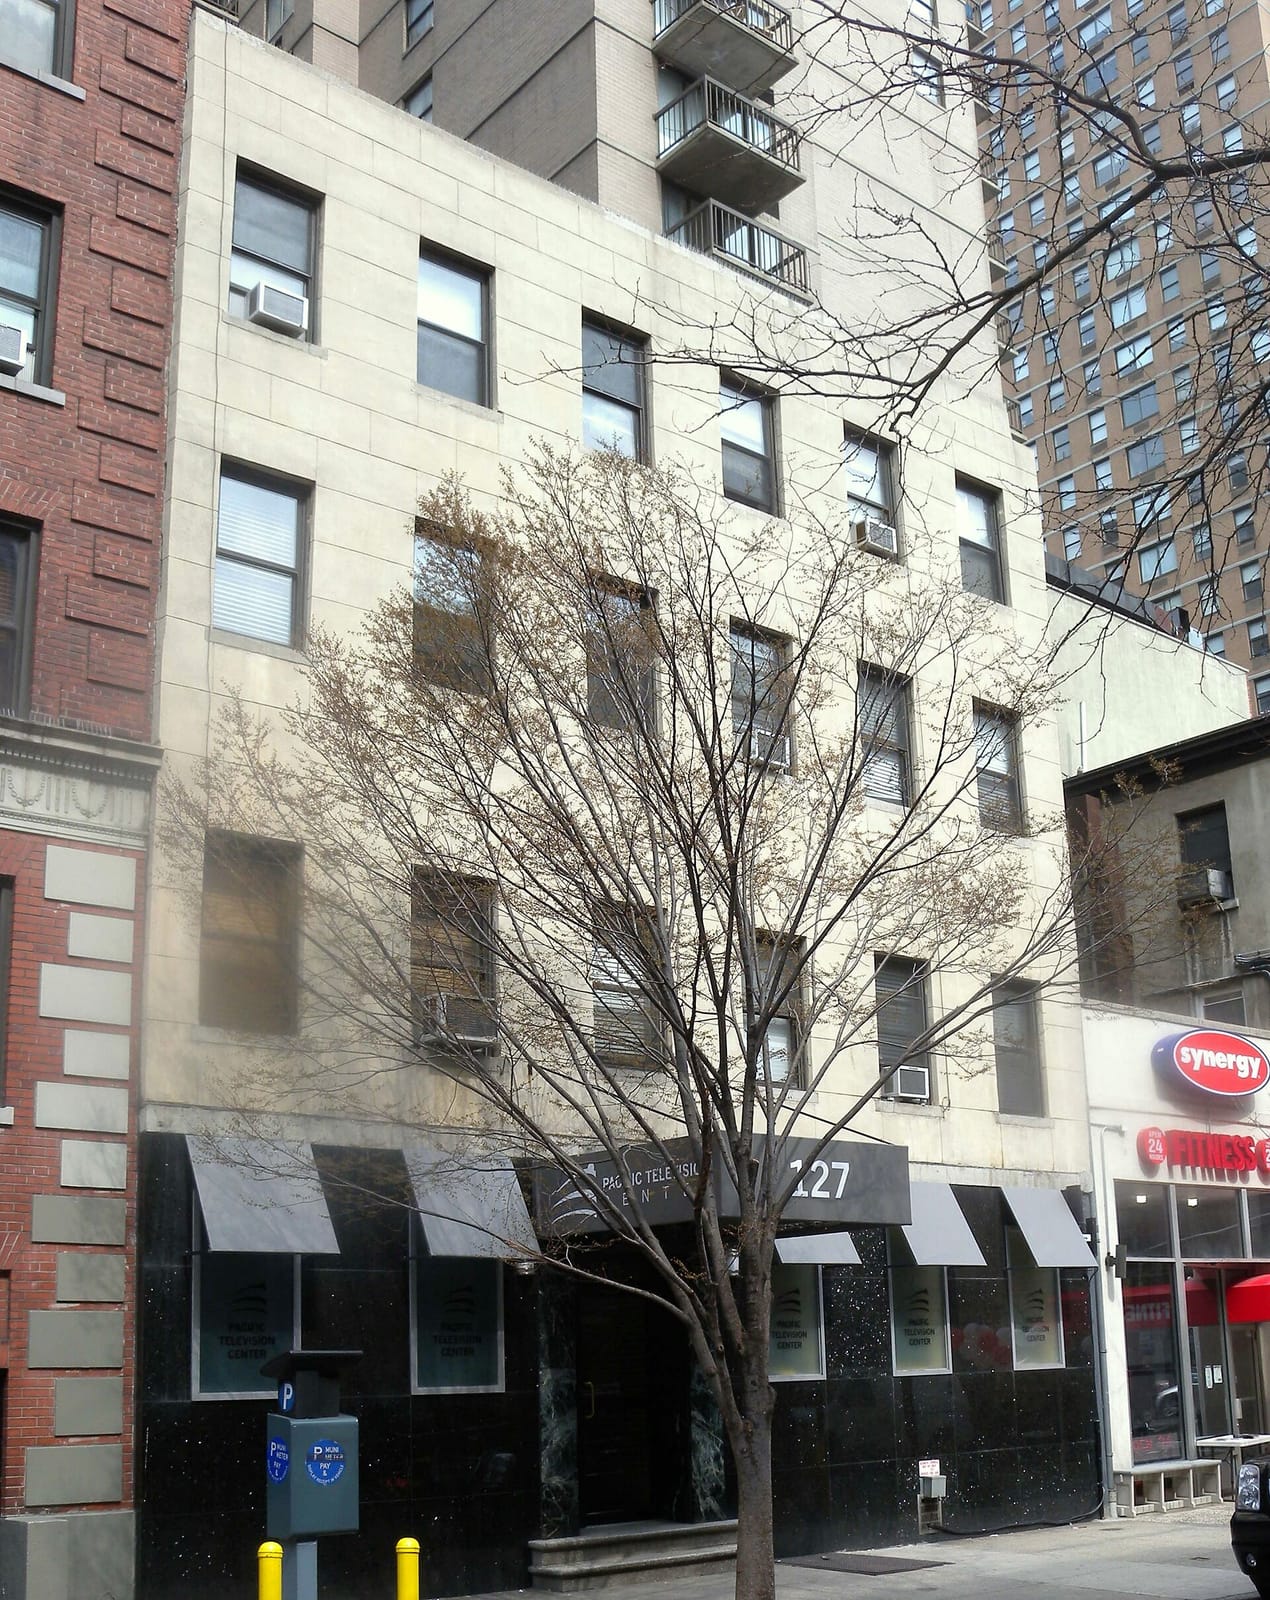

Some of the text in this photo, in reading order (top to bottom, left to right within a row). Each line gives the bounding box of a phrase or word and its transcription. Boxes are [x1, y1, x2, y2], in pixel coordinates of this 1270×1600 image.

[1180, 1046, 1261, 1079] synergy
[1148, 1138, 1163, 1153] 24
[1168, 1130, 1257, 1171] FITNESS
[602, 1171, 642, 1190] PACIC
[790, 1159, 850, 1199] 127
[219, 1335, 276, 1346] TELEVISION
[228, 1349, 267, 1360] CENTER
[283, 1383, 293, 1410] P
[270, 1441, 277, 1457] P
[313, 1446, 323, 1460] P
[320, 1462, 331, 1470] PAY
